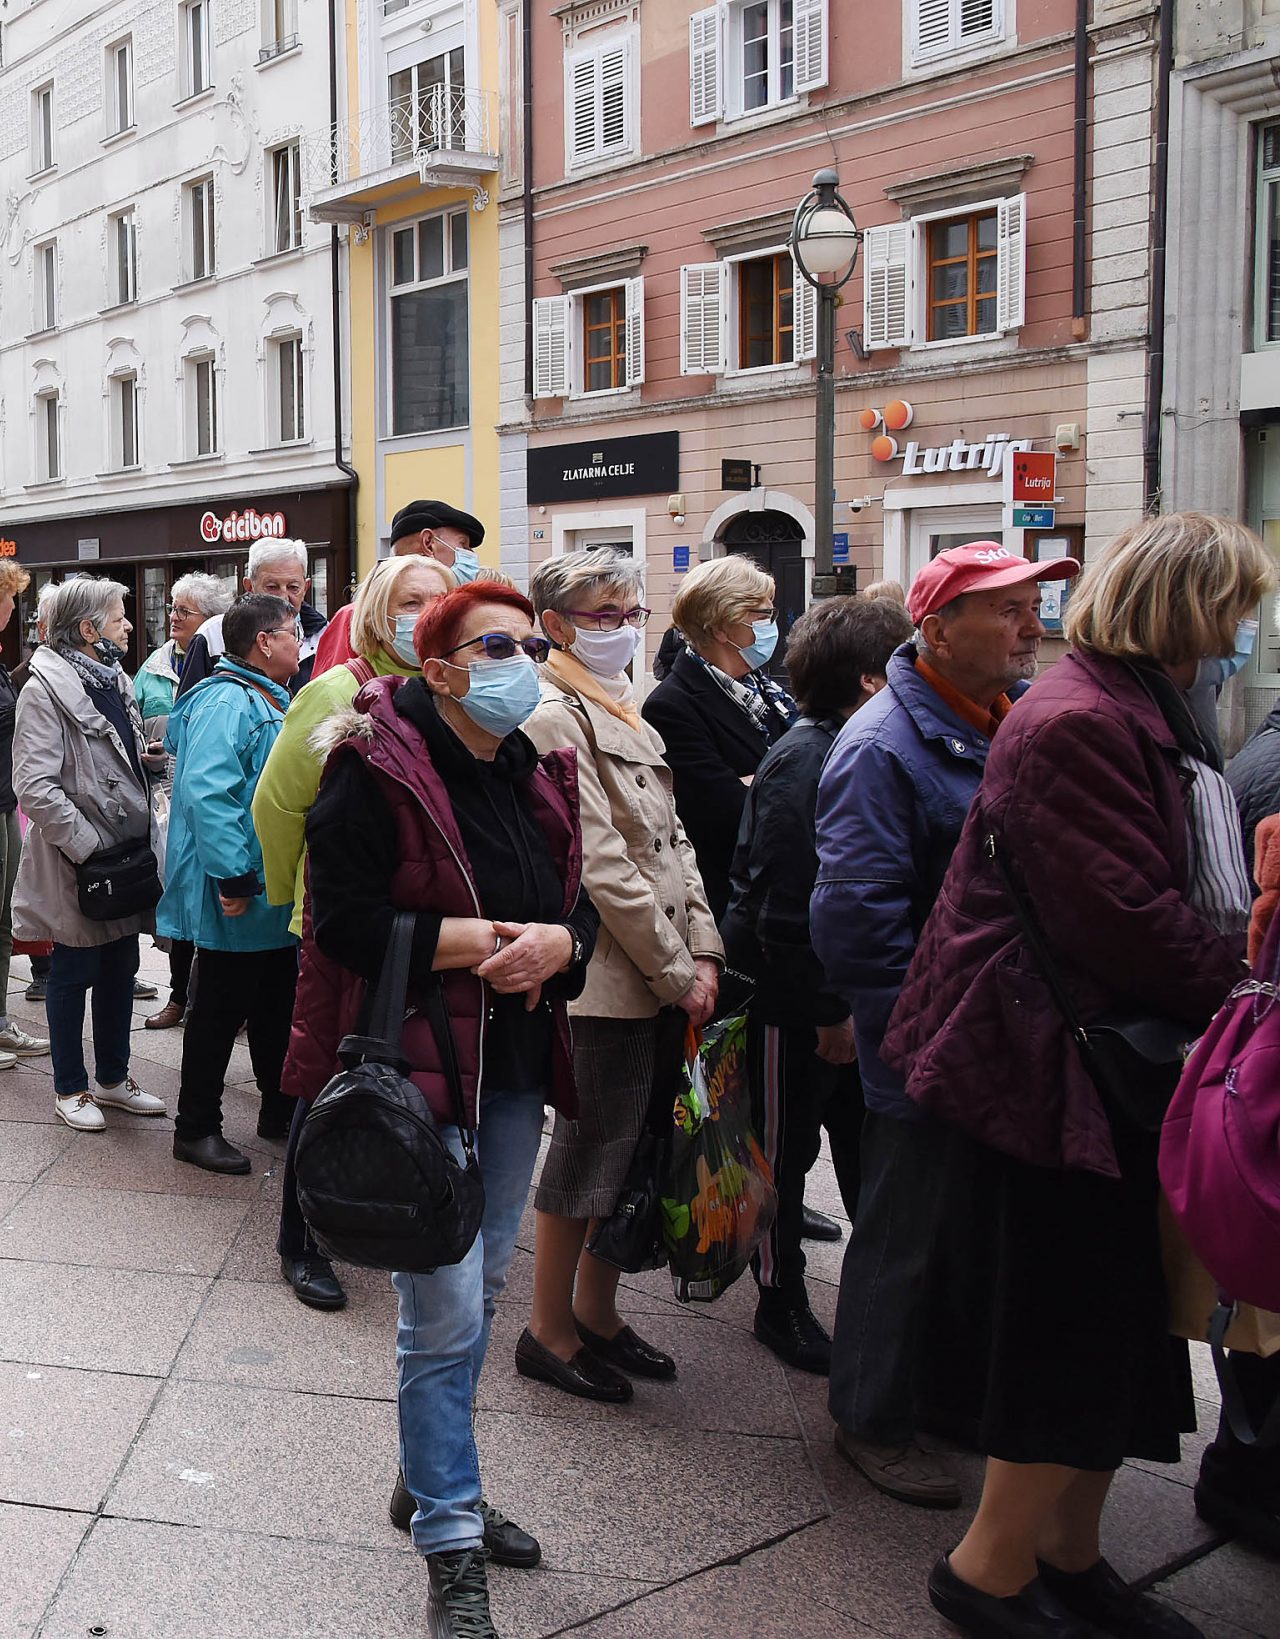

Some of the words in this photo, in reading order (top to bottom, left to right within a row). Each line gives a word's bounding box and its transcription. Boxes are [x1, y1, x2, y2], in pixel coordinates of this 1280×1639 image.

[562, 465, 608, 481] ZLATARNA
[608, 463, 635, 477] CELJE
[1024, 476, 1051, 490] Lutrija
[223, 510, 286, 541] ciciban
